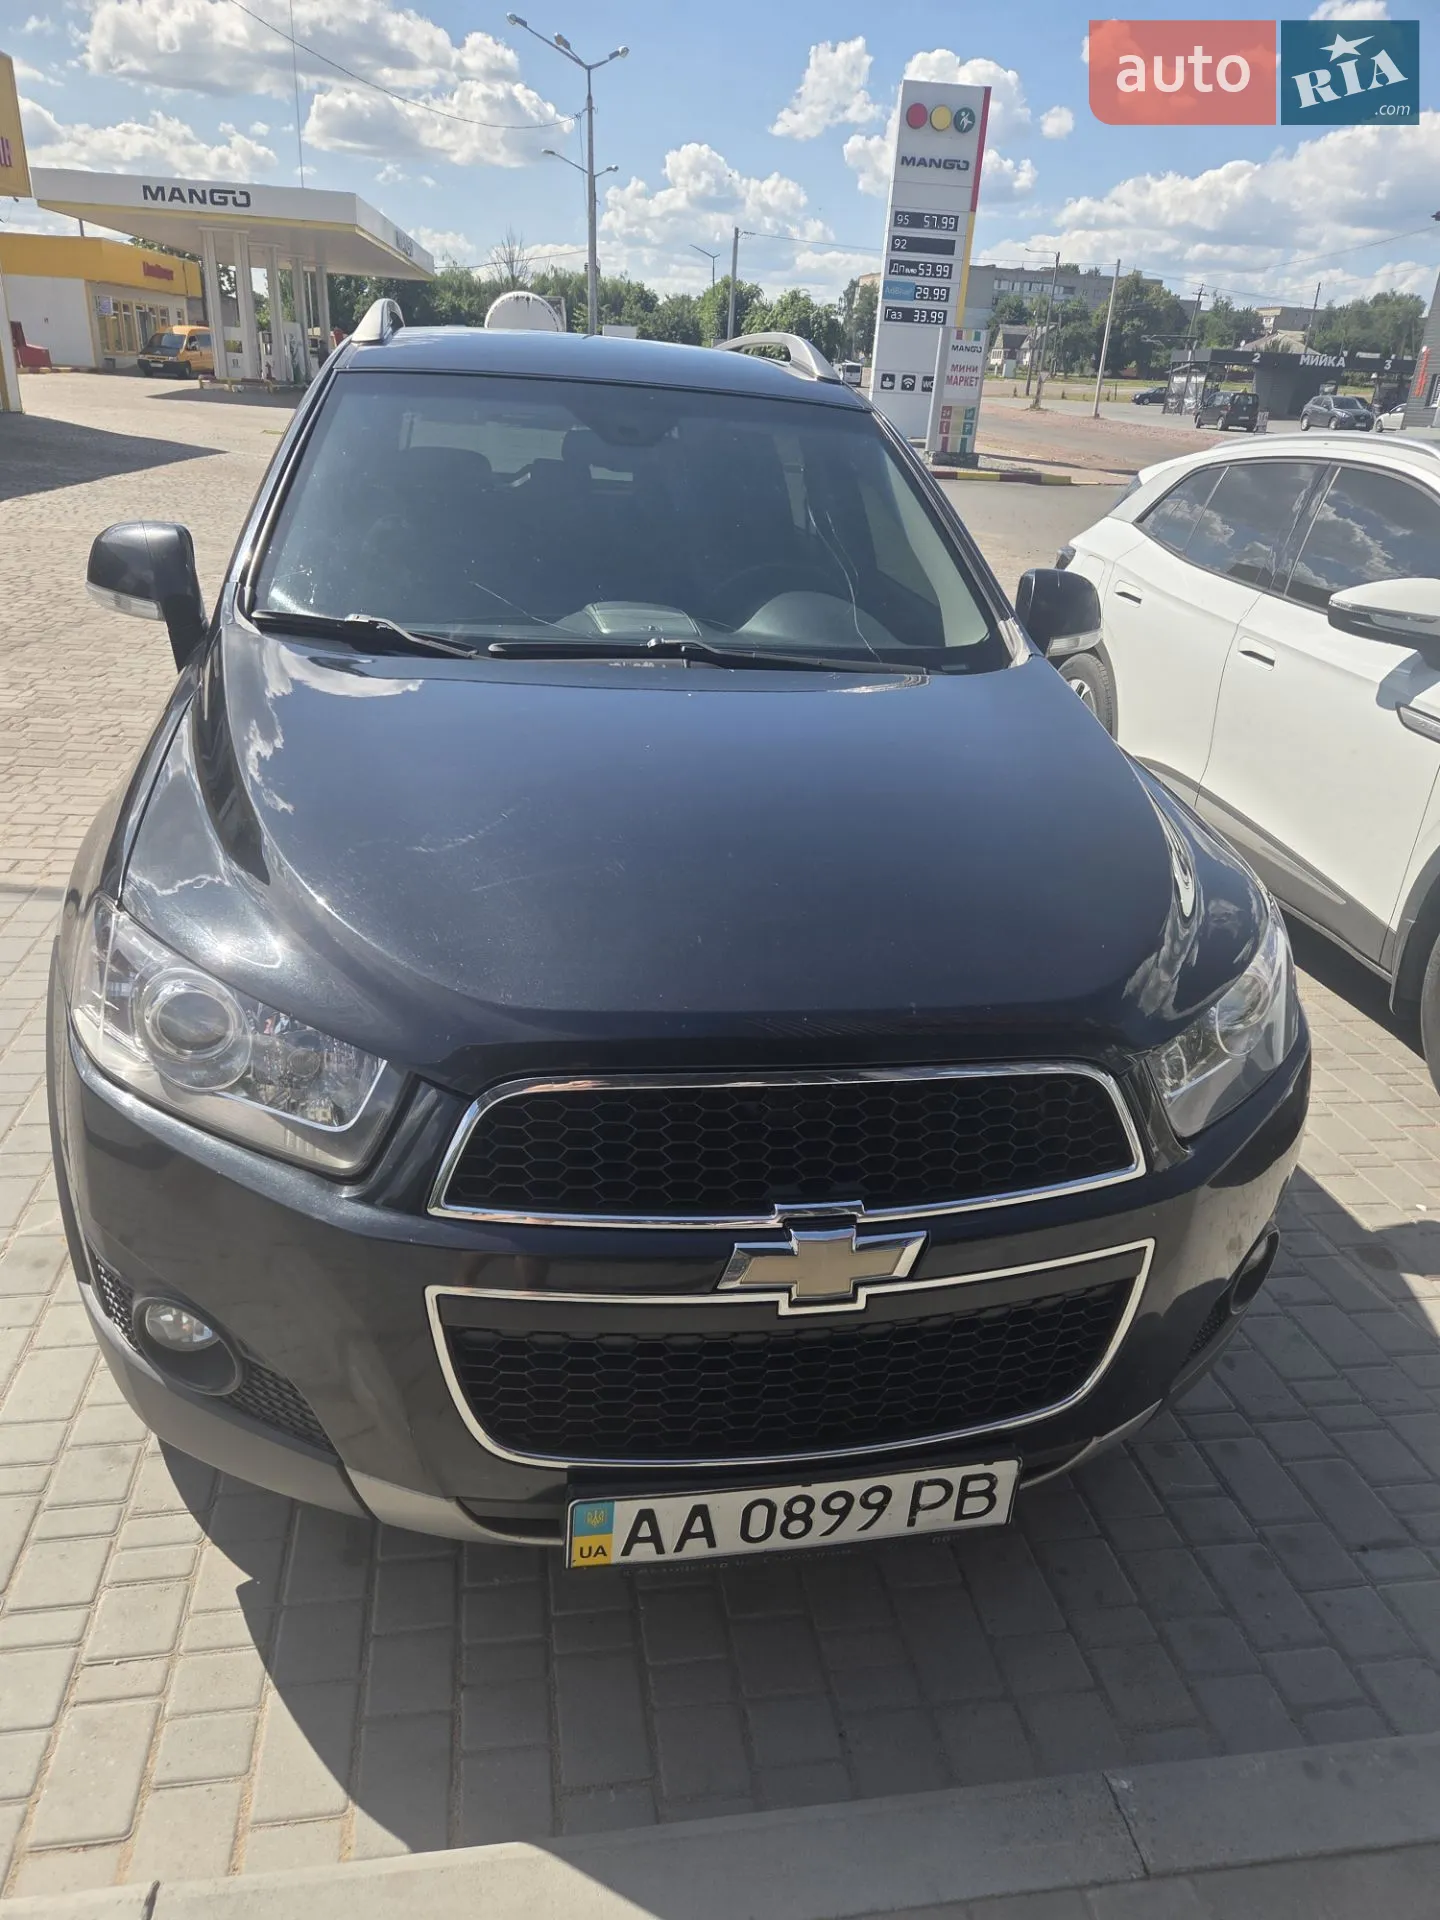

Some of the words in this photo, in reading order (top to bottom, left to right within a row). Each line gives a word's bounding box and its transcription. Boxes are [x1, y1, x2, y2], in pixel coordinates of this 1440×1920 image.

[901, 155, 970, 171] MANGO
[142, 185, 251, 208] MANGO
[897, 214, 910, 225] 95
[923, 215, 955, 230] 57.99
[894, 238, 907, 250] 92
[918, 263, 950, 277] 53.99
[915, 286, 947, 301] 29.99
[886, 309, 903, 320] Газ
[913, 310, 944, 324] 33.99
[951, 344, 983, 354] MANGO
[950, 364, 979, 373] МИНИ
[1252, 352, 1261, 363] 2
[1299, 352, 1346, 368] МИЙКА
[1384, 359, 1393, 370] 3
[945, 375, 980, 387] МАРКЕТ
[620, 1503, 718, 1556] AA
[739, 1484, 893, 1545] 0899
[906, 1472, 998, 1528] PB
[579, 1544, 608, 1559] UA
